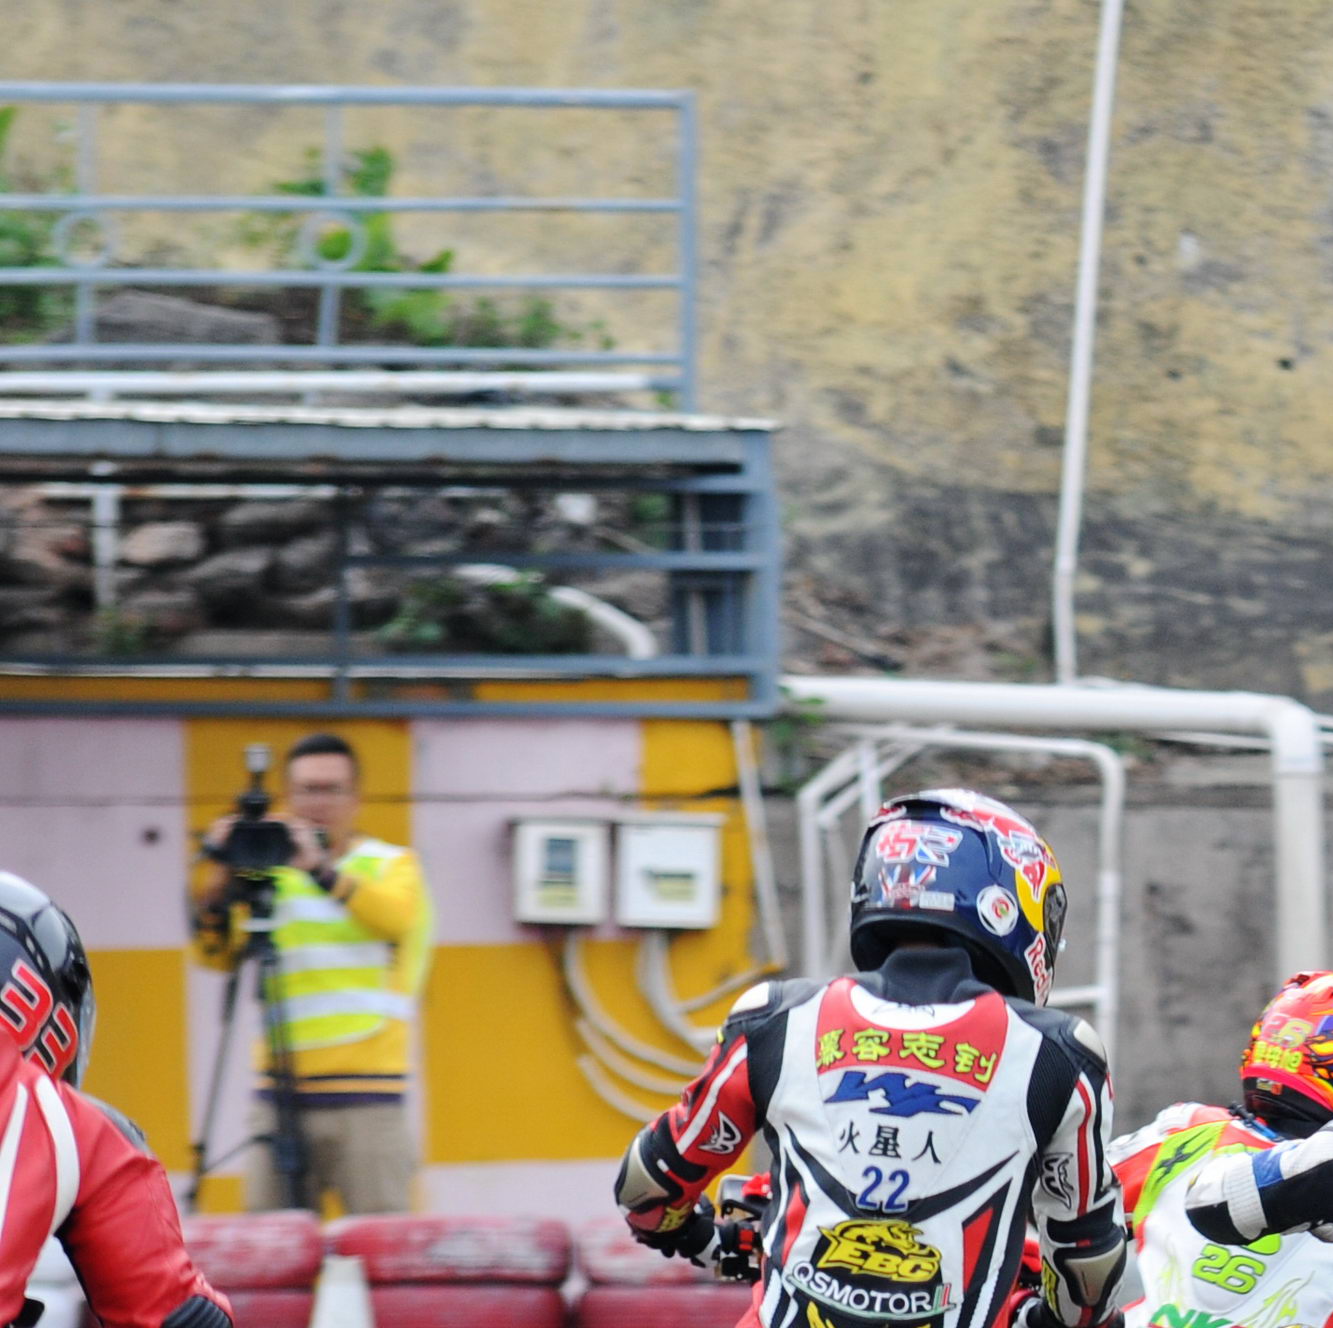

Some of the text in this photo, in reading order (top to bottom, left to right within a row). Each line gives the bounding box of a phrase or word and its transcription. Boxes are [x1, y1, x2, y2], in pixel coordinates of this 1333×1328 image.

[838, 1120, 942, 1164] 火星人
[857, 1166, 911, 1212] 22
[836, 1242, 938, 1281] EBC
[1192, 1243, 1267, 1295] 26
